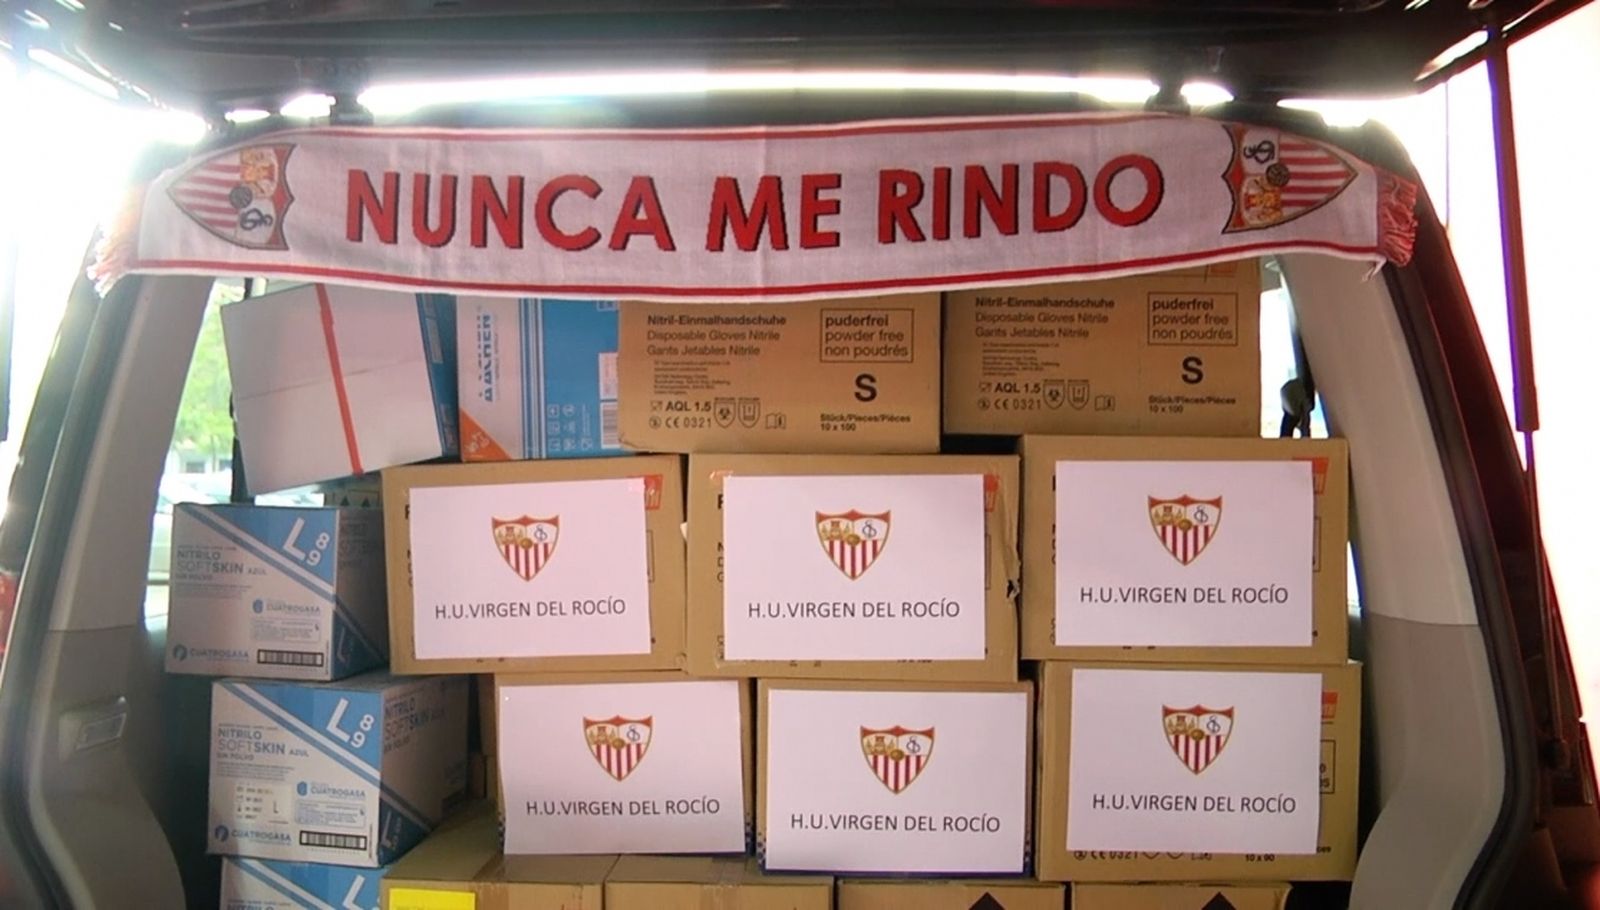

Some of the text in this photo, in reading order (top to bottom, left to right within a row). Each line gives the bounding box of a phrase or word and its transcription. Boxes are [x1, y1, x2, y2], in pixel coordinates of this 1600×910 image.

[346, 153, 1165, 252] NUNCA ME RINDO
[1152, 299, 1214, 312] puderfrei
[647, 315, 787, 327] Nitril-Einmalhandschuhe
[825, 315, 889, 328] puderfrei
[975, 313, 1109, 325] Disposable Gloves Nitrile
[1153, 314, 1229, 326] powder free
[647, 330, 781, 343] Disposable Gloves Nitrile
[825, 330, 905, 344] powder free
[975, 327, 1089, 338] Gants Jetables Nitrile
[1153, 327, 1233, 341] non poudrés
[647, 345, 761, 356] Gants Jetables Nitrile
[825, 344, 909, 359] non poudrés
[1182, 356, 1204, 384] S
[854, 373, 877, 402] S
[994, 383, 1041, 394] AQL 1.5
[665, 401, 712, 412] AQL 1.5
[1013, 399, 1041, 411] 0321
[684, 417, 712, 429] 0321
[283, 517, 330, 566] L 8 9
[176, 549, 221, 560] NITRILO
[177, 561, 244, 574] SOFTSKIN
[1080, 583, 1289, 604] H.U.VIRGEN DEL ROCÍO
[435, 596, 626, 620] H.U.VIRGEN DEL ROCÍO
[748, 597, 961, 619] H.U.VIRGEN DEL ROCÍO
[326, 697, 375, 748] L 8 9
[218, 727, 262, 740] NITRILO
[218, 739, 286, 755] SOFTSKIN
[310, 785, 366, 798] CUATROGASA
[526, 795, 720, 816] H.U.VIRGEN DEL ROCÍO
[1092, 793, 1296, 813] H.U.VIRGEN DEL ROCÍO
[791, 811, 1001, 833] H.U.VIRGEN DEL ROCÍO
[232, 830, 292, 842] CUATROGASA
